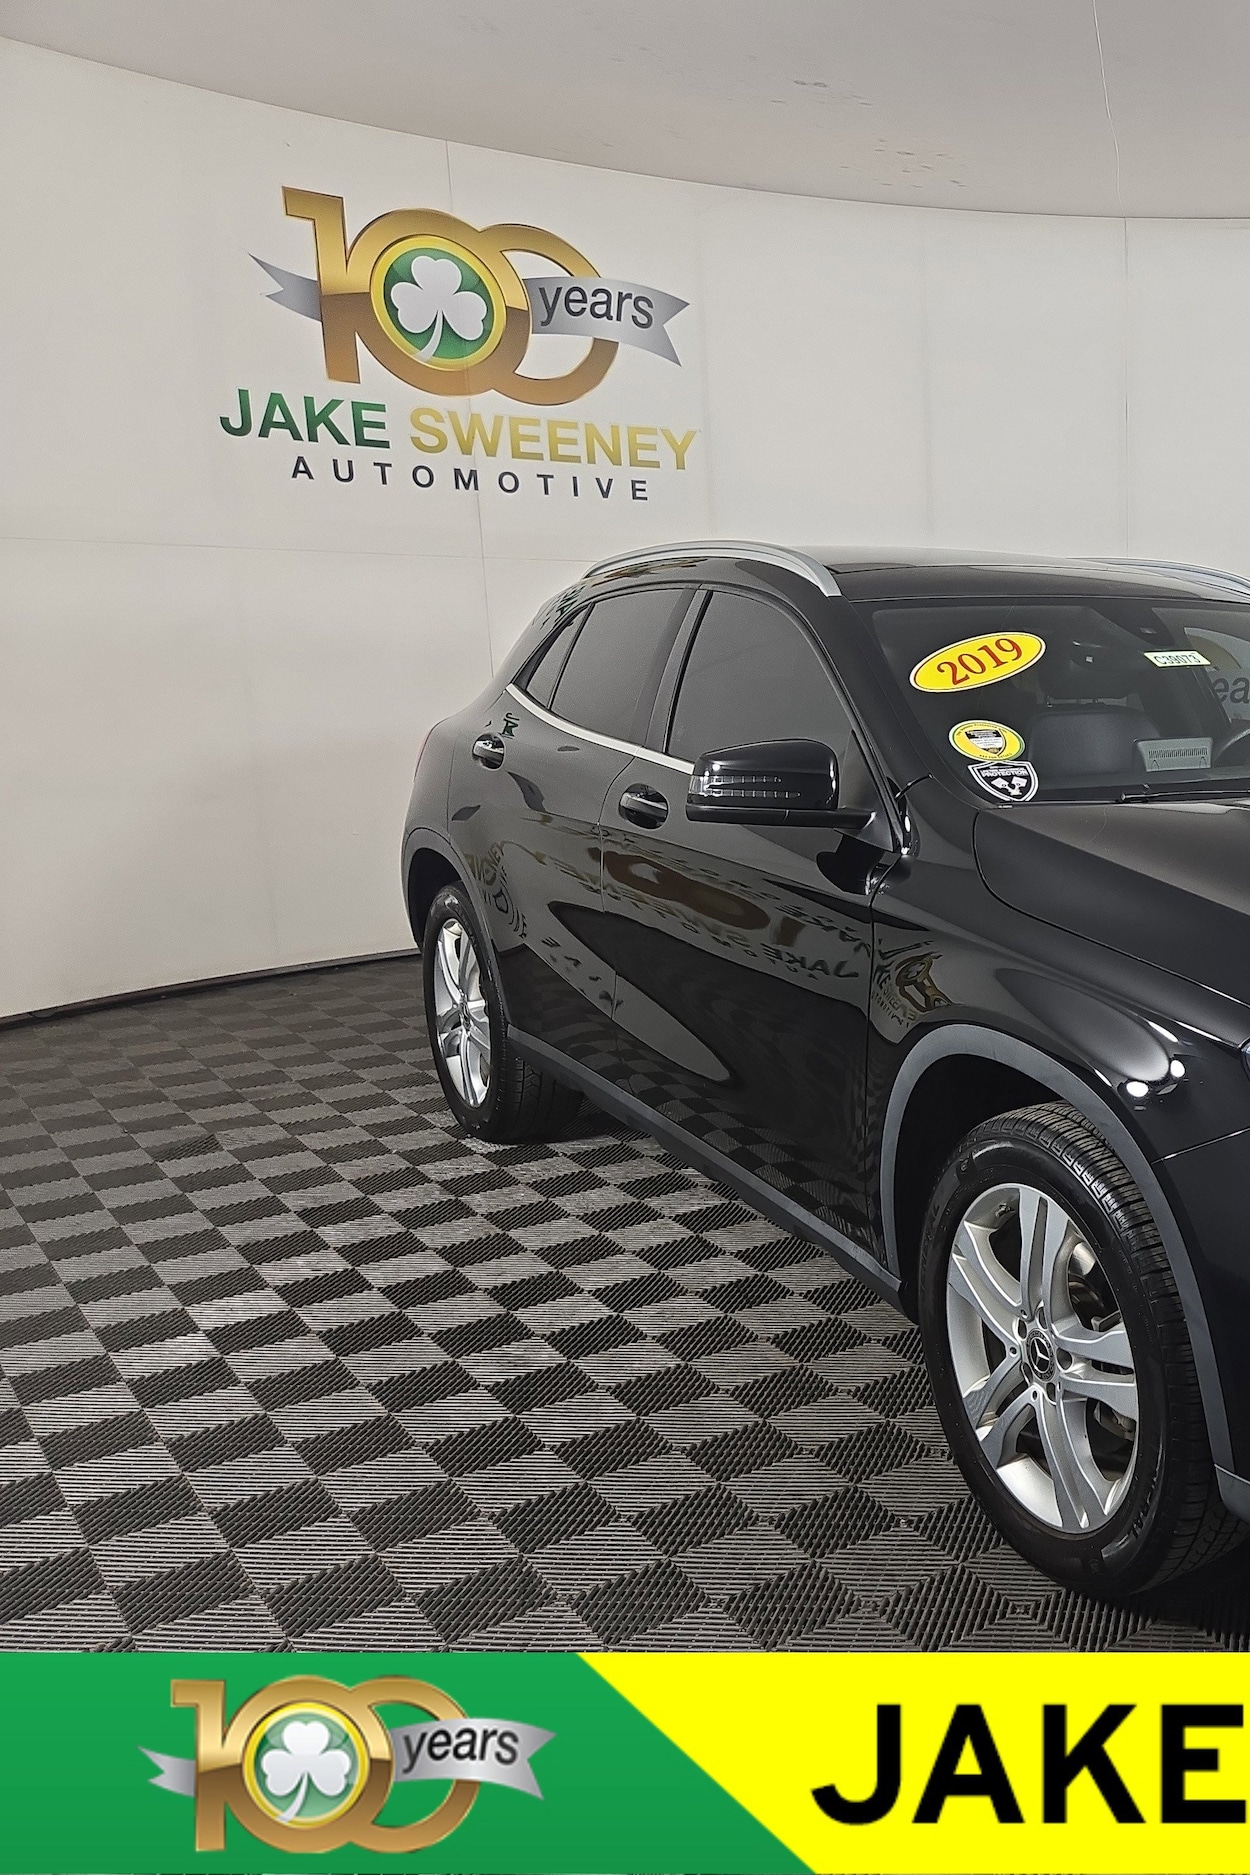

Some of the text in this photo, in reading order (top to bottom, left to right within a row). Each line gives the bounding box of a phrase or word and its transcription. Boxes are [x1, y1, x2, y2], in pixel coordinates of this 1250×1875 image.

[538, 284, 655, 329] years
[219, 388, 697, 471] JAKE SWEENEY
[291, 455, 648, 501] AUTOMOTIVE
[936, 638, 1023, 686] 2019
